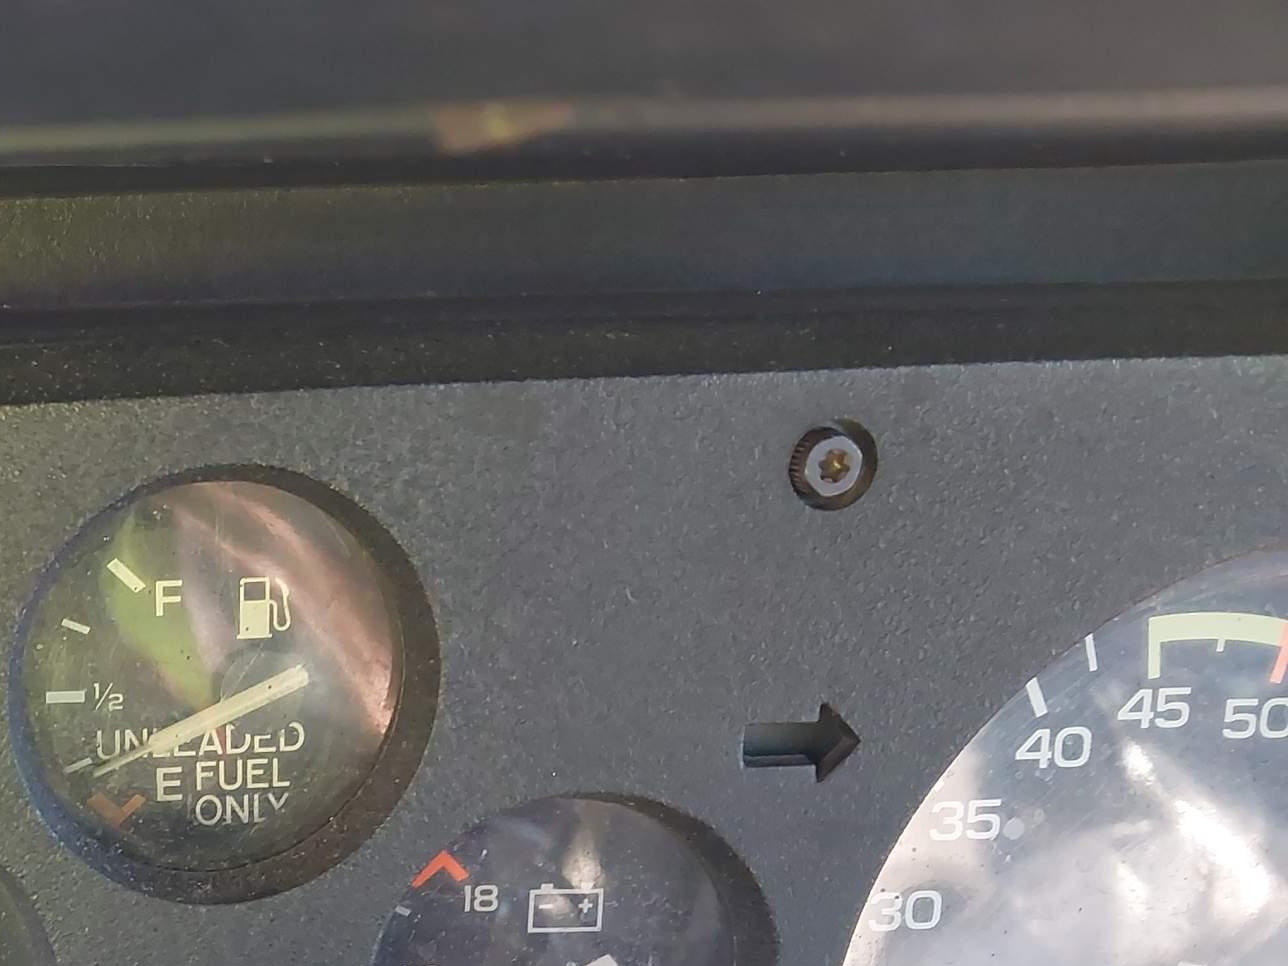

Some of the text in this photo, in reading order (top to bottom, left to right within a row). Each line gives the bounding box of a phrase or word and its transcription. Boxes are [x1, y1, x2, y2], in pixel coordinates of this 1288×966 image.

[156, 579, 183, 616] F
[1117, 687, 1192, 729] 45
[1222, 697, 1288, 739] 50
[1015, 726, 1093, 769] 40
[156, 766, 183, 801] E
[196, 758, 291, 791] FUEL
[195, 792, 289, 826] ONLY
[928, 799, 1002, 842] 35
[464, 885, 499, 913] 18
[866, 890, 943, 932] 30
